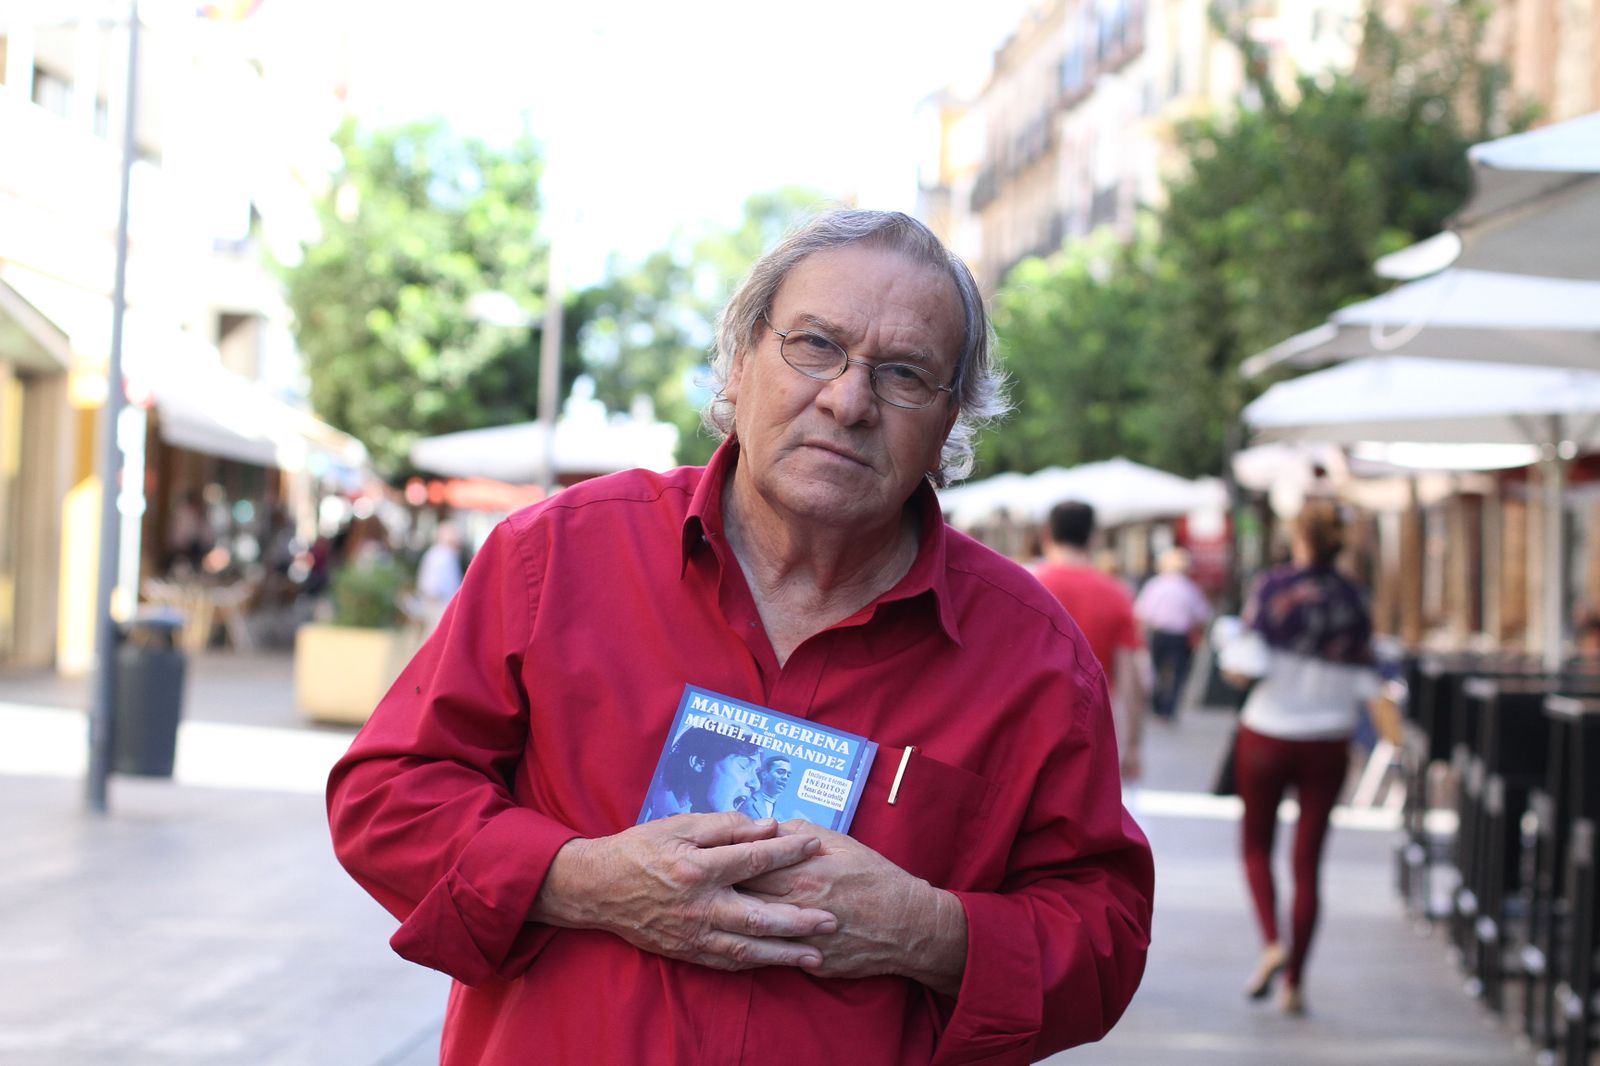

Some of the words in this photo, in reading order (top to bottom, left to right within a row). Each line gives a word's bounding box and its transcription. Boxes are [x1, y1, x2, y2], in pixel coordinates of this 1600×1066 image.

[685, 714, 746, 741] MIGUEL
[749, 732, 846, 771] HERNÁNDEZ
[691, 697, 769, 731] MANUEL
[774, 722, 850, 755] GERENA
